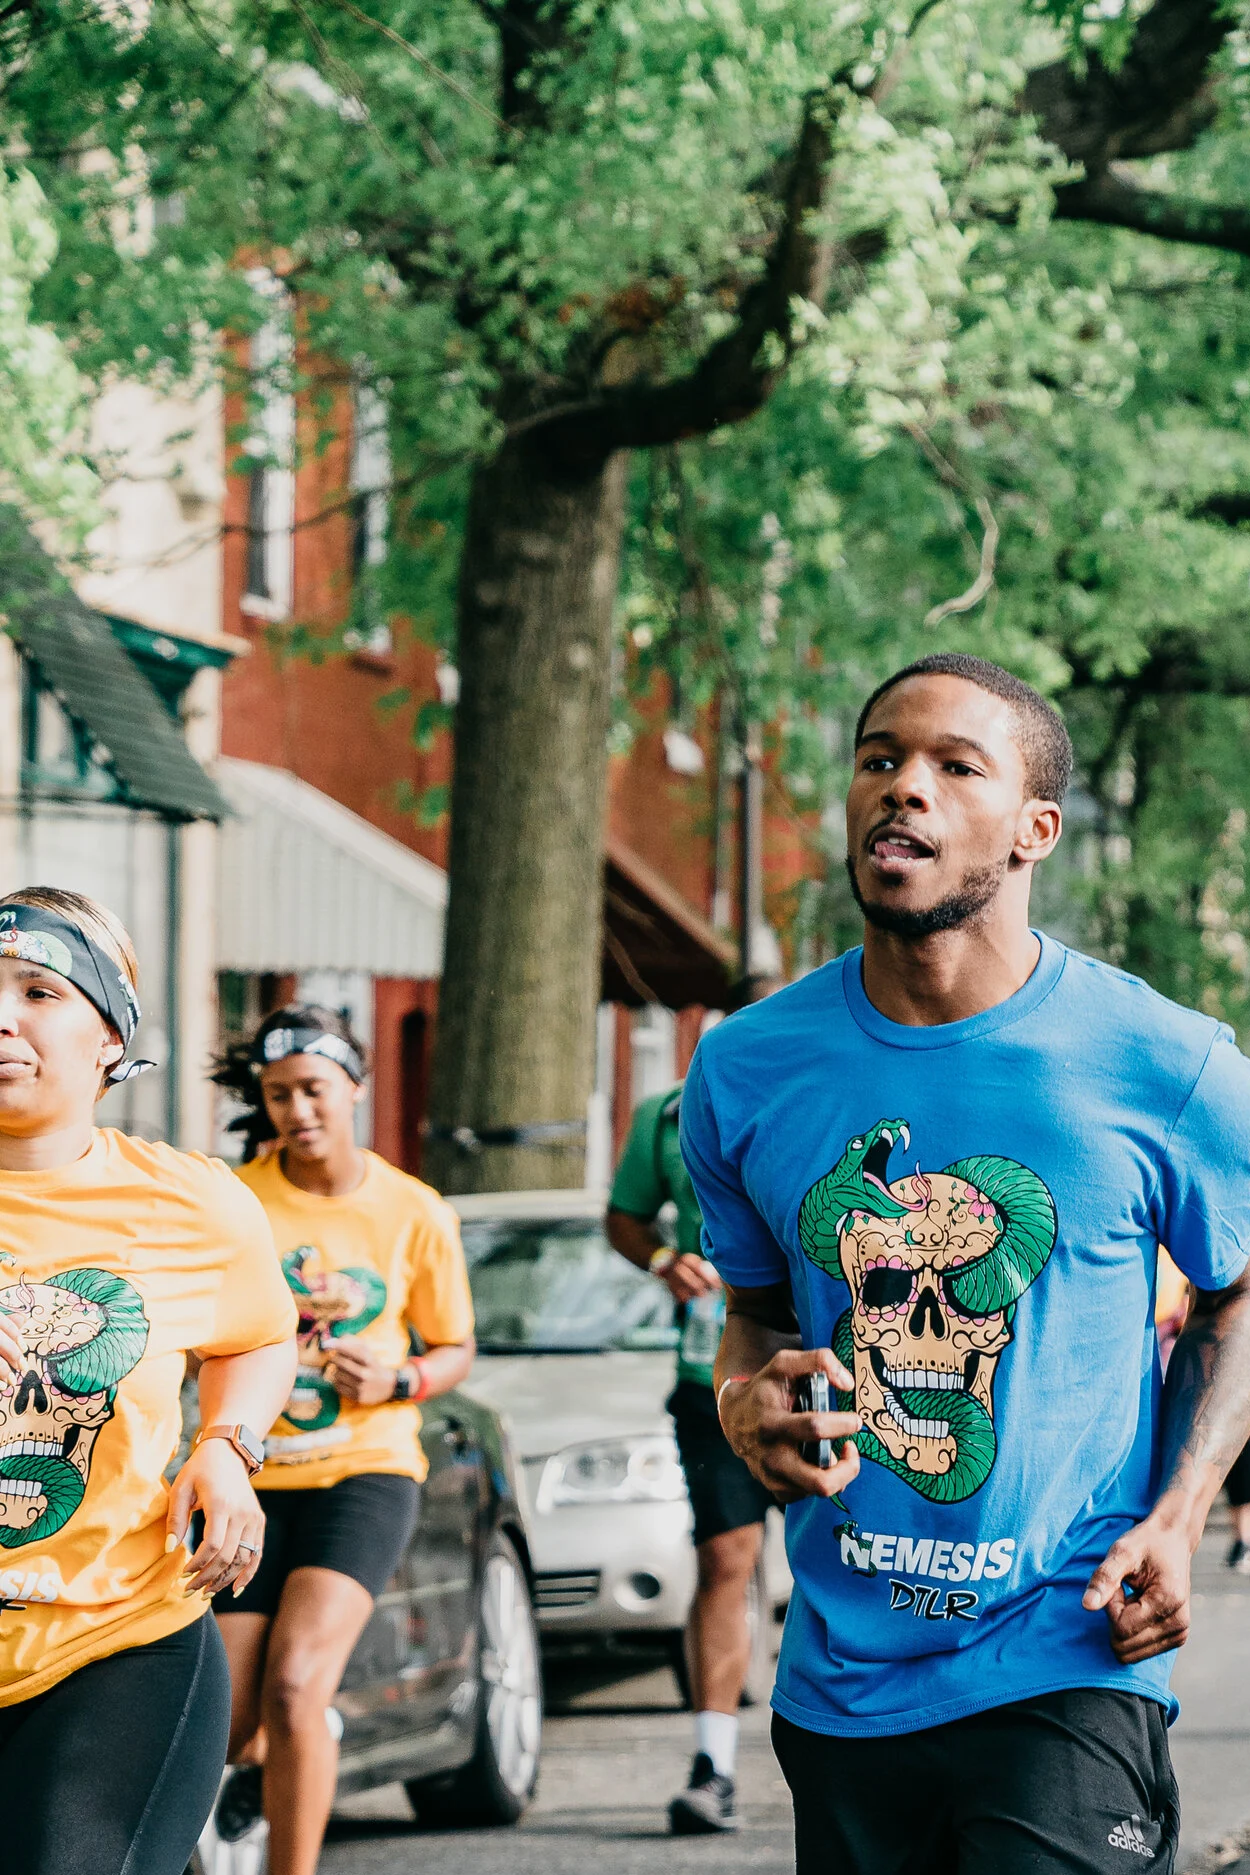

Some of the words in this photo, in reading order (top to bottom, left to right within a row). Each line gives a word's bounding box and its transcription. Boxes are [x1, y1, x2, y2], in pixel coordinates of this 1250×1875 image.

[839, 1531, 1016, 1583] NEMESIS
[888, 1578, 980, 1621] DTLR
[1107, 1833, 1156, 1858] adidas
